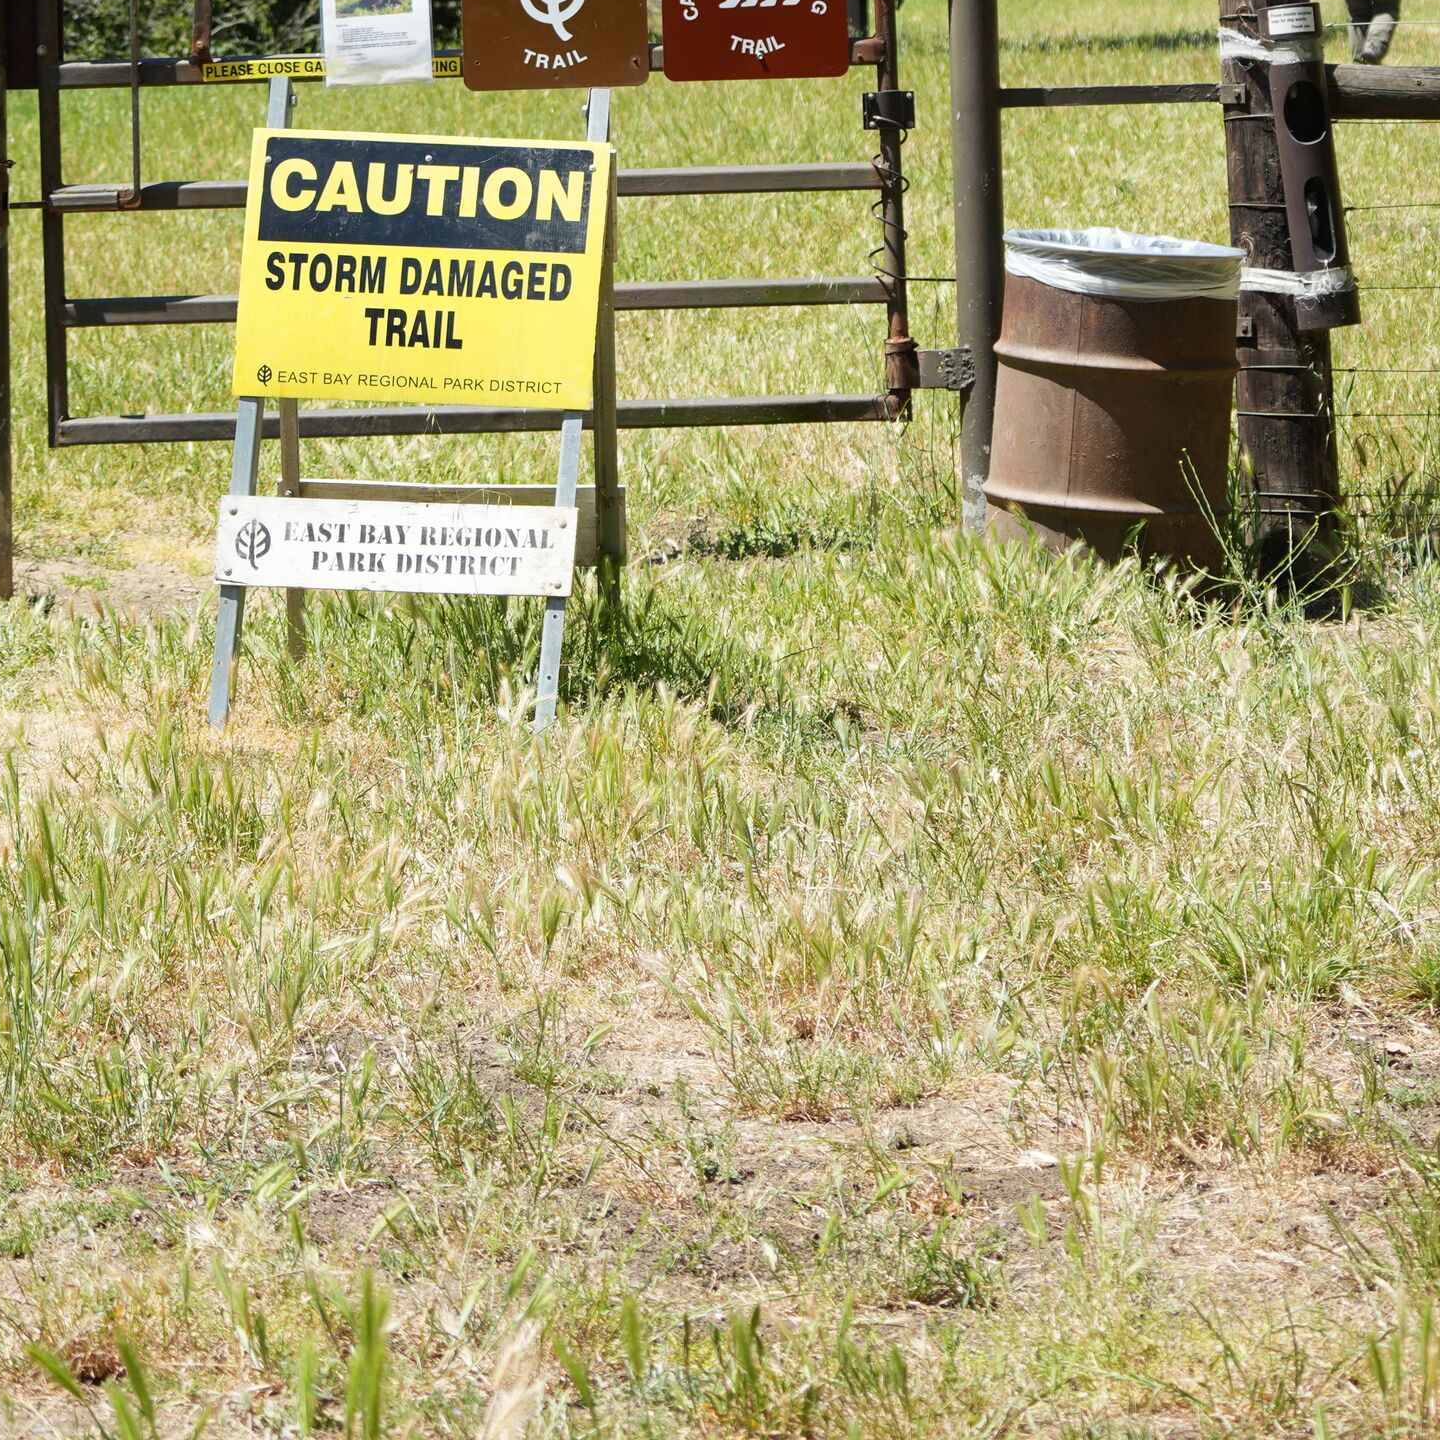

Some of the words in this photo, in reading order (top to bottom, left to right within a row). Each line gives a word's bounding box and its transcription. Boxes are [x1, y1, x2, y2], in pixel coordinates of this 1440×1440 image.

[730, 34, 786, 55] TRAIL
[206, 64, 254, 78] PLEASE
[258, 62, 300, 74] CLOSE
[523, 48, 588, 69] TRAIL
[269, 157, 585, 222] CAUTION
[265, 251, 387, 294] STORM
[399, 257, 572, 302] DAMAGED
[365, 307, 463, 350] TRAIL
[278, 370, 318, 384] EAST
[323, 372, 353, 386] BAY
[358, 373, 438, 390] REGIONAL
[443, 377, 485, 392] PARK
[490, 379, 563, 395] DISTRICT
[283, 521, 351, 543] EAST
[359, 524, 412, 546] BAY
[419, 525, 554, 550] REGIONAL
[311, 550, 386, 573] PARK
[395, 553, 523, 577] DISTRICT
